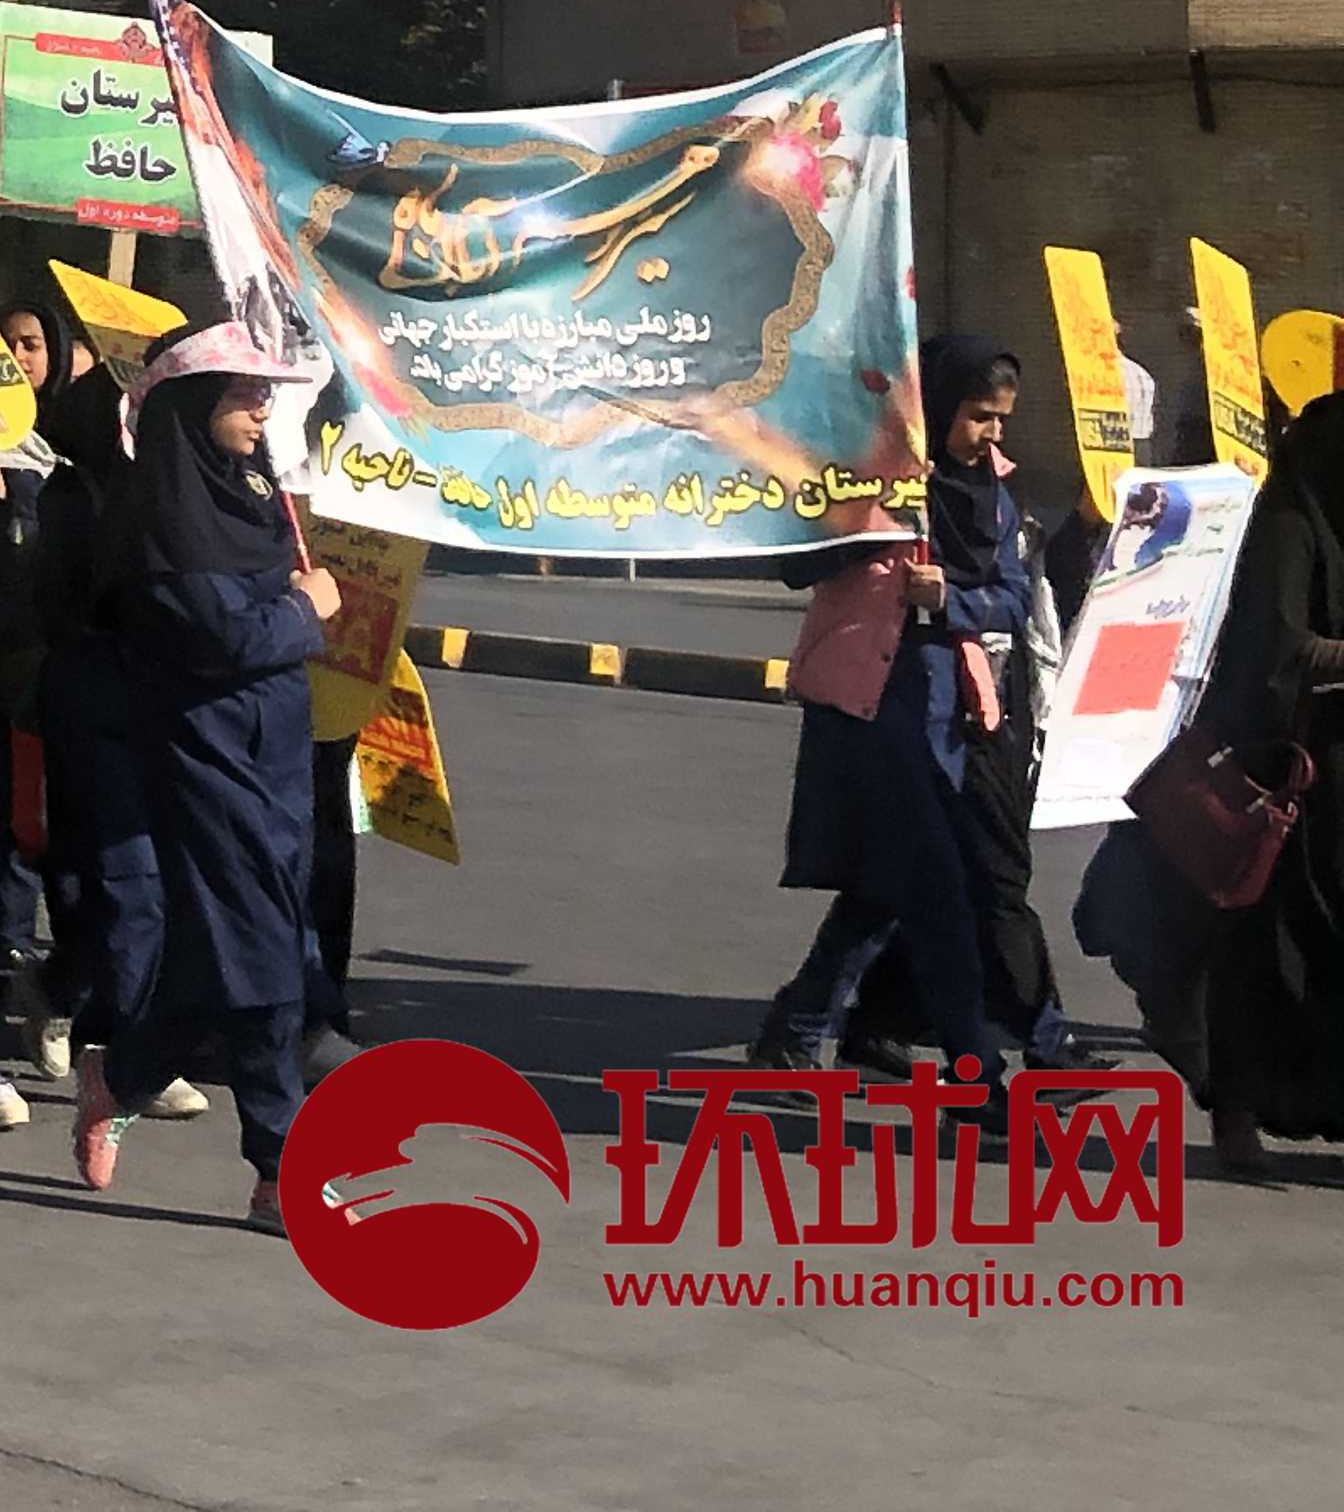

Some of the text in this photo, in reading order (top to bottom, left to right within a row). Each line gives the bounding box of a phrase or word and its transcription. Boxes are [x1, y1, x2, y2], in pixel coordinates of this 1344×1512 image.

[83, 138, 177, 183] حافظ
[378, 311, 438, 346] جهانی
[541, 309, 613, 349] مبارزه
[615, 305, 668, 345] ملی
[668, 309, 711, 343] روز
[443, 349, 504, 392] گرامی
[320, 419, 346, 476] ۲
[341, 442, 416, 493] ناحیه
[495, 474, 540, 530] اول
[546, 476, 657, 530] متوسطه
[663, 470, 786, 529] دخترانه
